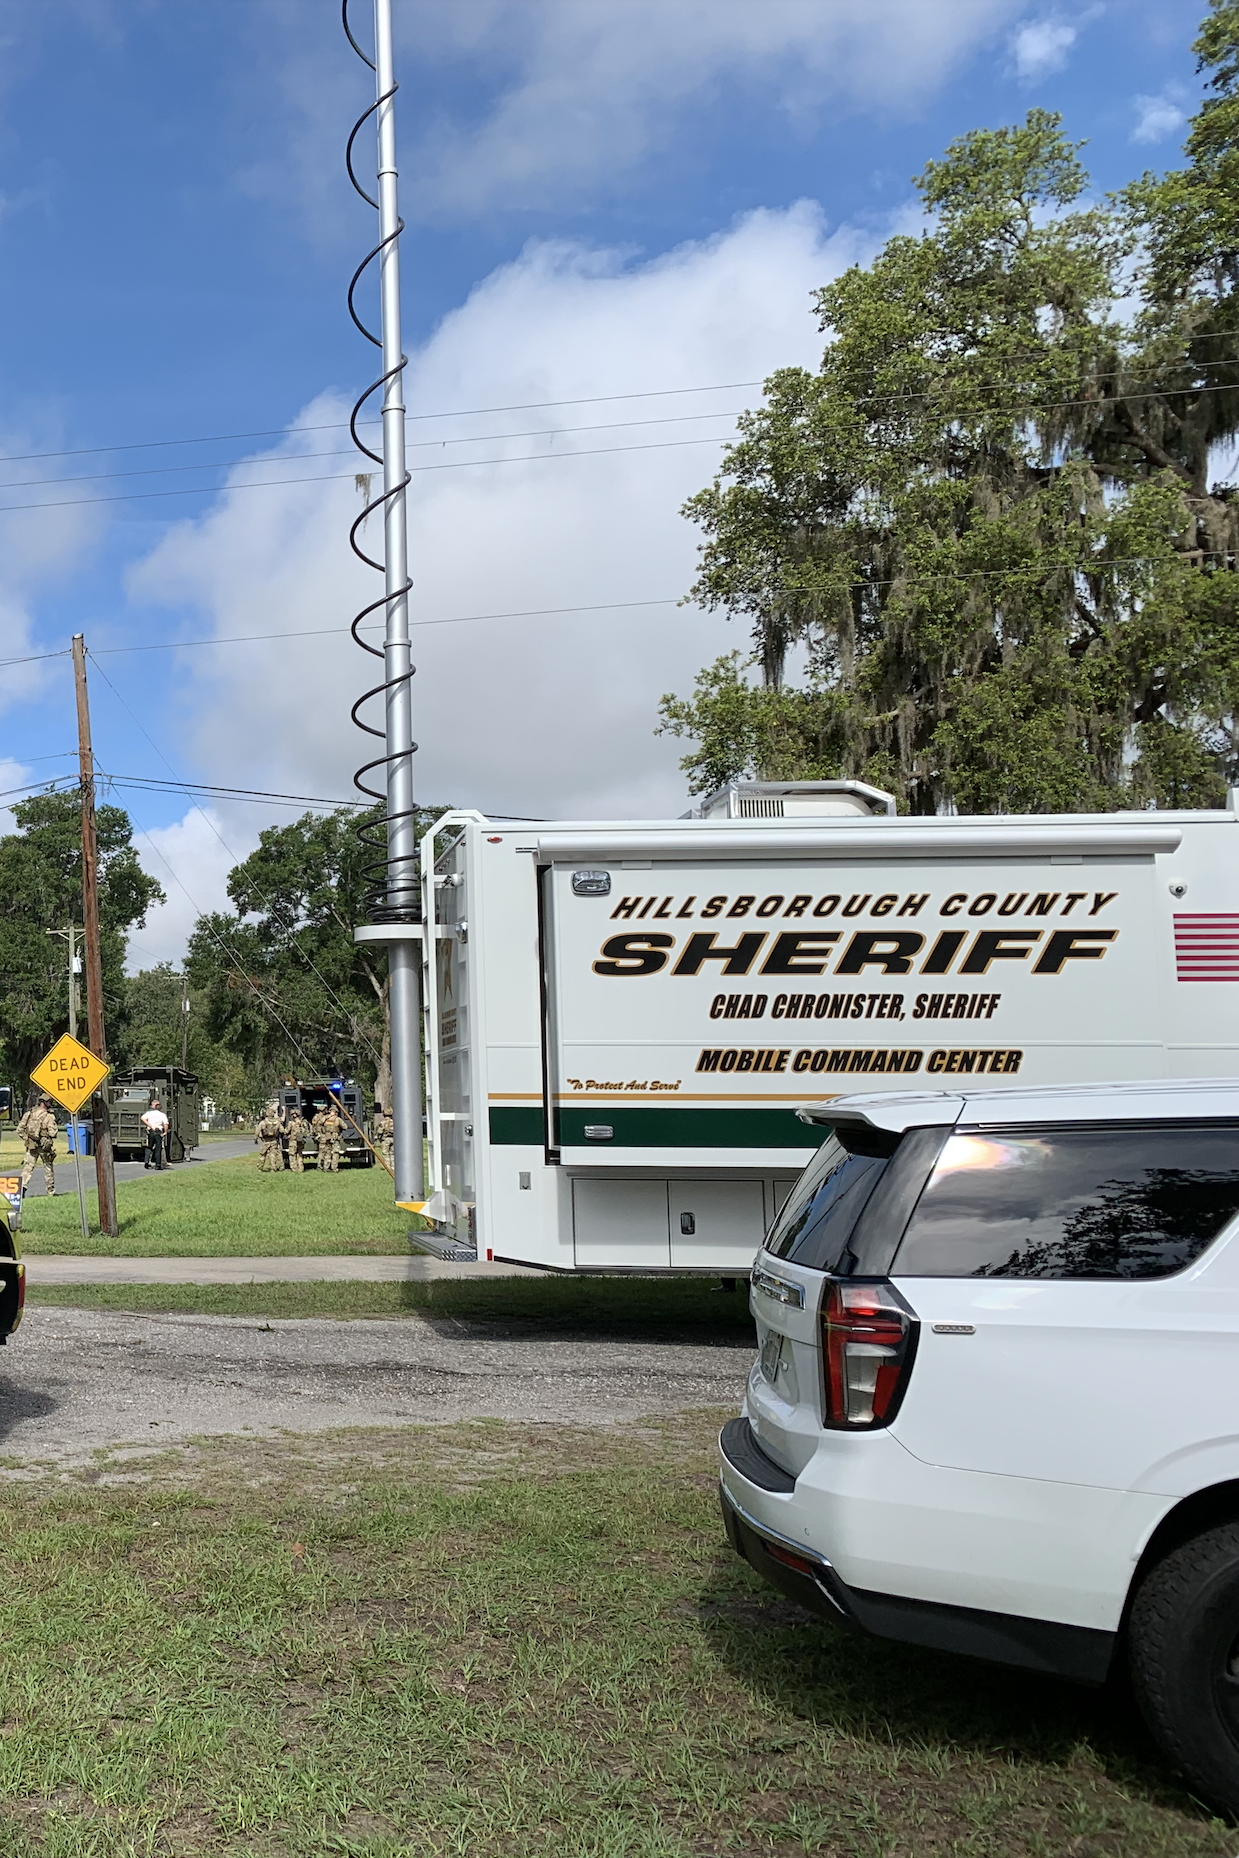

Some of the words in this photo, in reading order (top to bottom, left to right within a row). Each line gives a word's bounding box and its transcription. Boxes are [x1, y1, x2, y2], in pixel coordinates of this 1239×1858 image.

[609, 892, 932, 920] HILLSBOROUGH
[946, 892, 1120, 917] COUNTY
[591, 929, 1120, 977] SHERIFF
[709, 994, 767, 1021] CHAD
[771, 994, 905, 1022] CHRONISTER,
[912, 994, 1001, 1020] SHERIFF
[49, 1056, 90, 1072] DEAD
[695, 1049, 790, 1074] MOBILE
[792, 1049, 923, 1074] COMMAND
[925, 1049, 1023, 1075] CENTER
[57, 1077, 86, 1091] END
[585, 1080, 624, 1091] Protect
[624, 1080, 648, 1091] And
